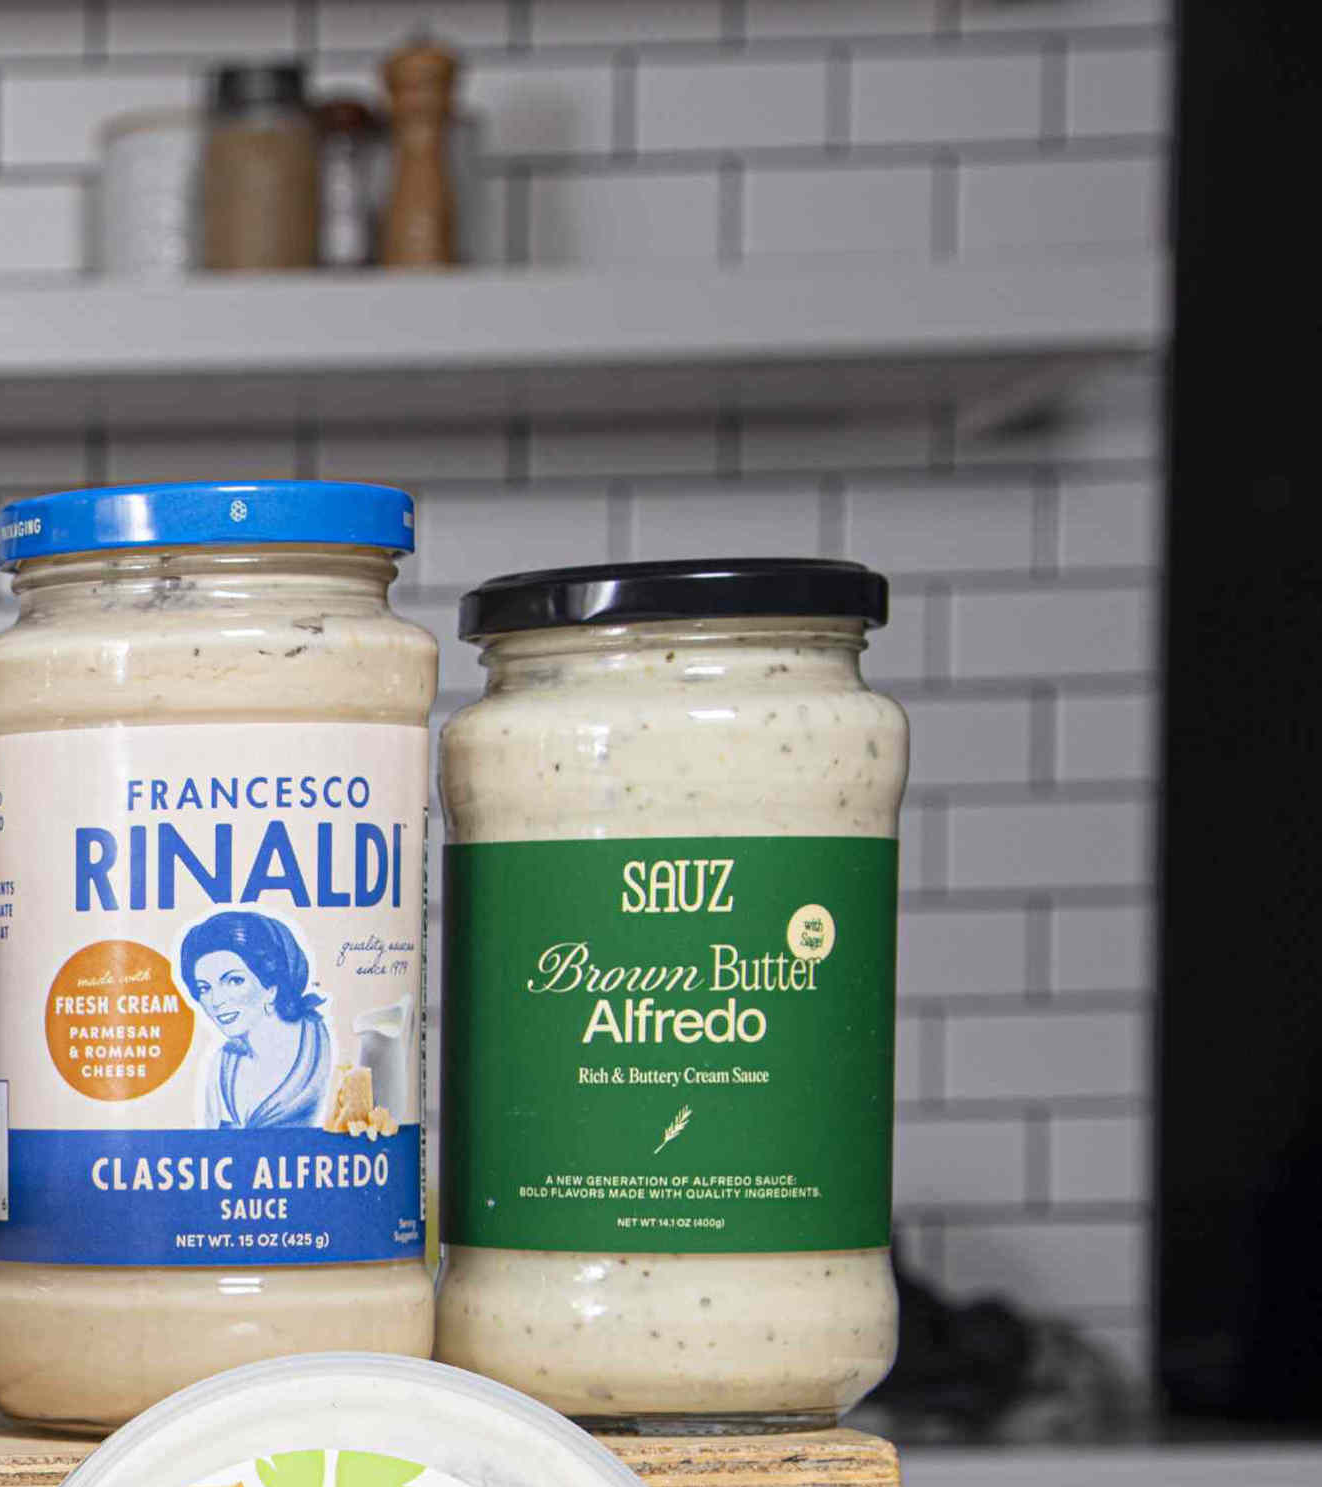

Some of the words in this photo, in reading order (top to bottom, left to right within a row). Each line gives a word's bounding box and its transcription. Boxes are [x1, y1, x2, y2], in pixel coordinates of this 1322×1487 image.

[127, 776, 370, 811] FRANCESCO
[75, 820, 402, 911] RINALDI
[622, 859, 734, 913] SAUZ
[527, 942, 704, 994] Brown
[710, 944, 820, 991] Butter
[55, 995, 108, 1015] FRESH
[117, 994, 178, 1014] CREAM
[582, 998, 766, 1043] Alfredo
[70, 1026, 160, 1039] PARMESAN
[70, 1046, 78, 1058] &
[85, 1045, 161, 1058] ROMANO
[81, 1065, 147, 1077] CHEESE
[579, 1067, 608, 1084] Rich
[612, 1069, 625, 1083] &
[629, 1067, 681, 1086] Buttery
[684, 1067, 729, 1084] Cream
[733, 1067, 769, 1083] Sauce
[92, 1157, 233, 1191] CLASSIC
[253, 1153, 389, 1188] ALFREDO
[546, 1176, 553, 1184] A
[557, 1176, 583, 1185] NEW
[586, 1176, 667, 1186] GENERATION
[672, 1176, 688, 1186] OF
[693, 1176, 751, 1186] ALFREDO
[221, 1199, 289, 1220] SAUCE
